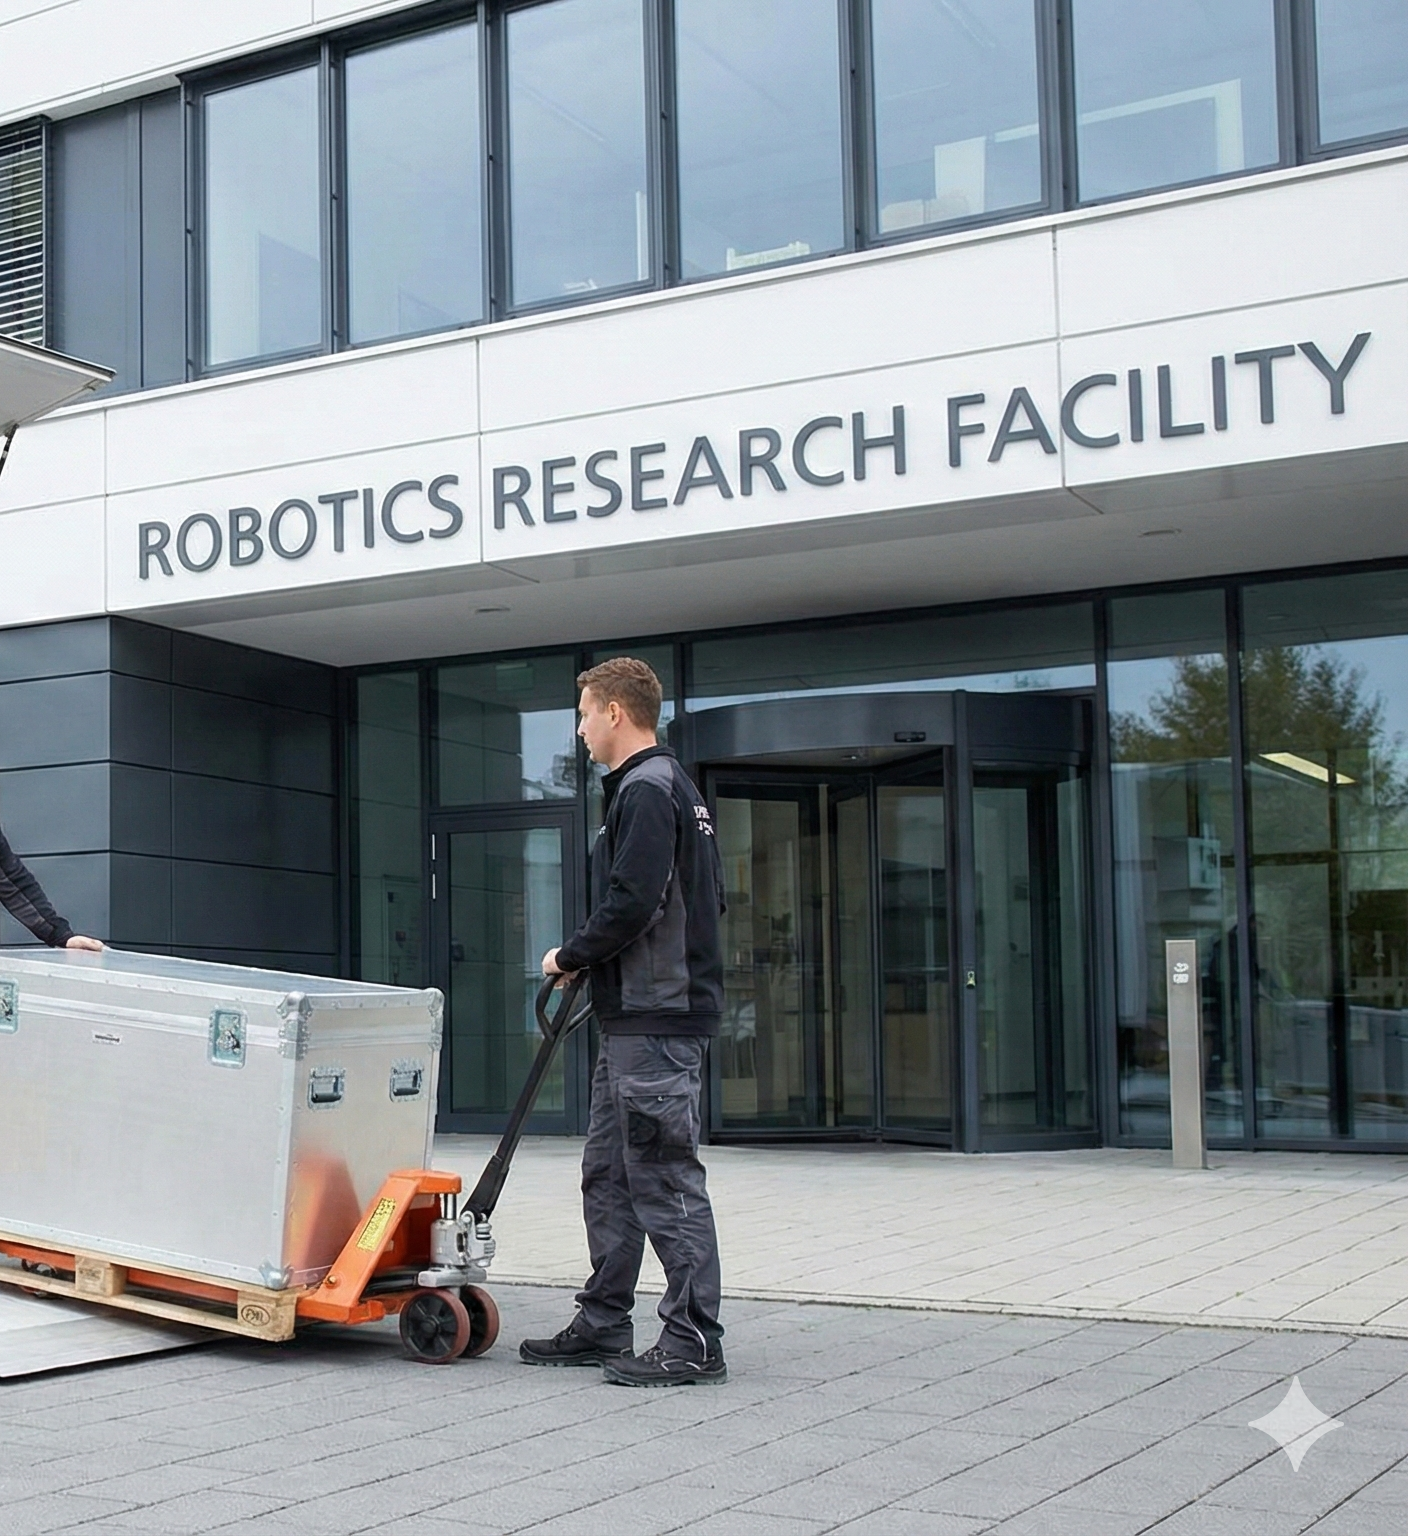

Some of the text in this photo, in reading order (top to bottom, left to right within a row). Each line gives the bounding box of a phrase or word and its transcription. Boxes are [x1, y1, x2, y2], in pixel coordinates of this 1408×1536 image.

[138, 331, 1372, 580] ROBOTICS RESEARCH FACILITY
